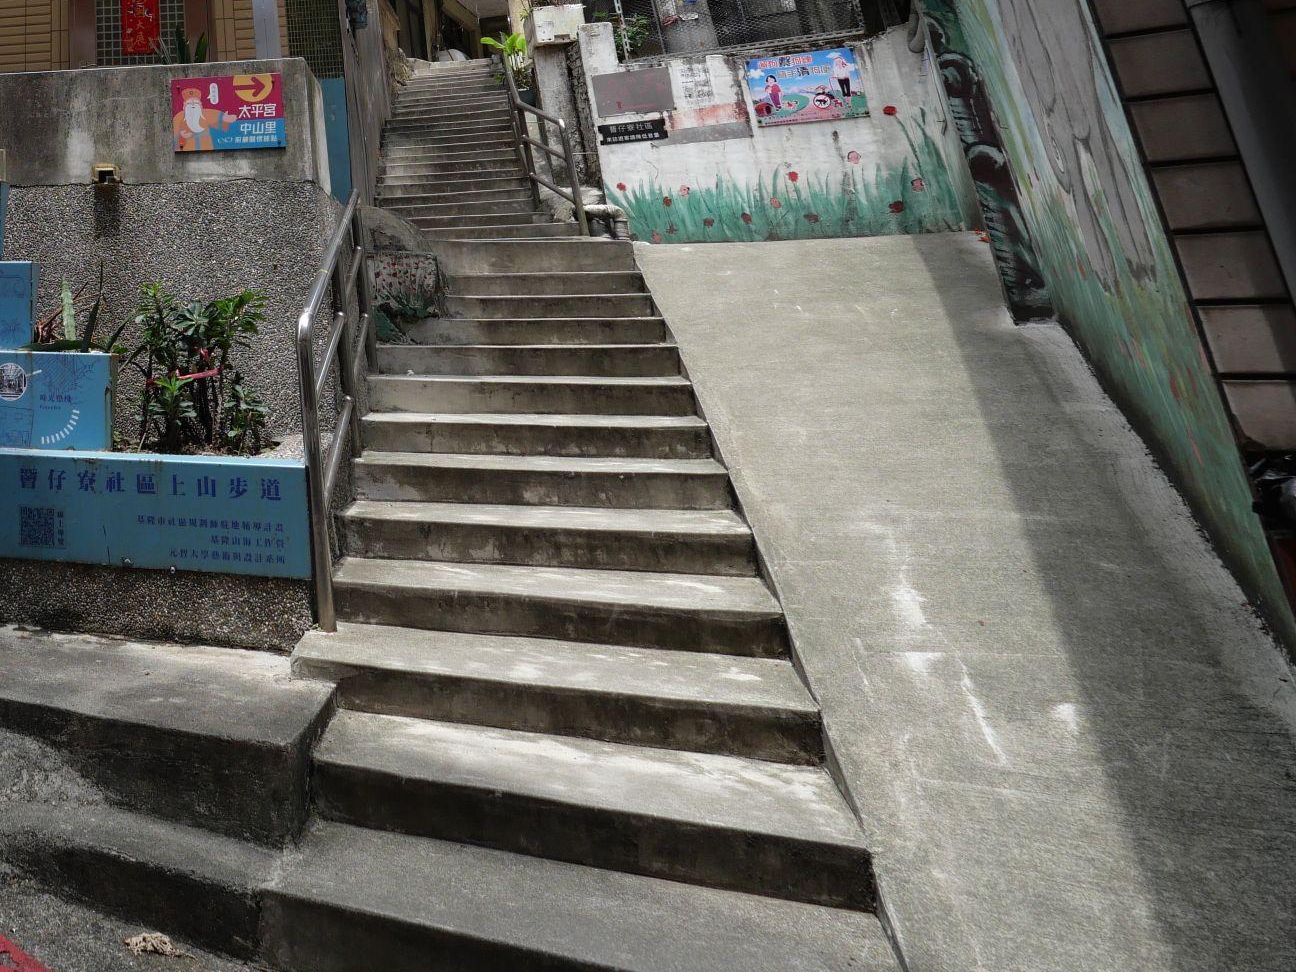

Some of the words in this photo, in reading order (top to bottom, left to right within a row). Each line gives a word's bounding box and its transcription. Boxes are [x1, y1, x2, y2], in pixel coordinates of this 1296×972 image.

[238, 103, 277, 119] 太平宮
[240, 121, 277, 135] 中山里
[210, 535, 285, 549] 基隆山海工作營
